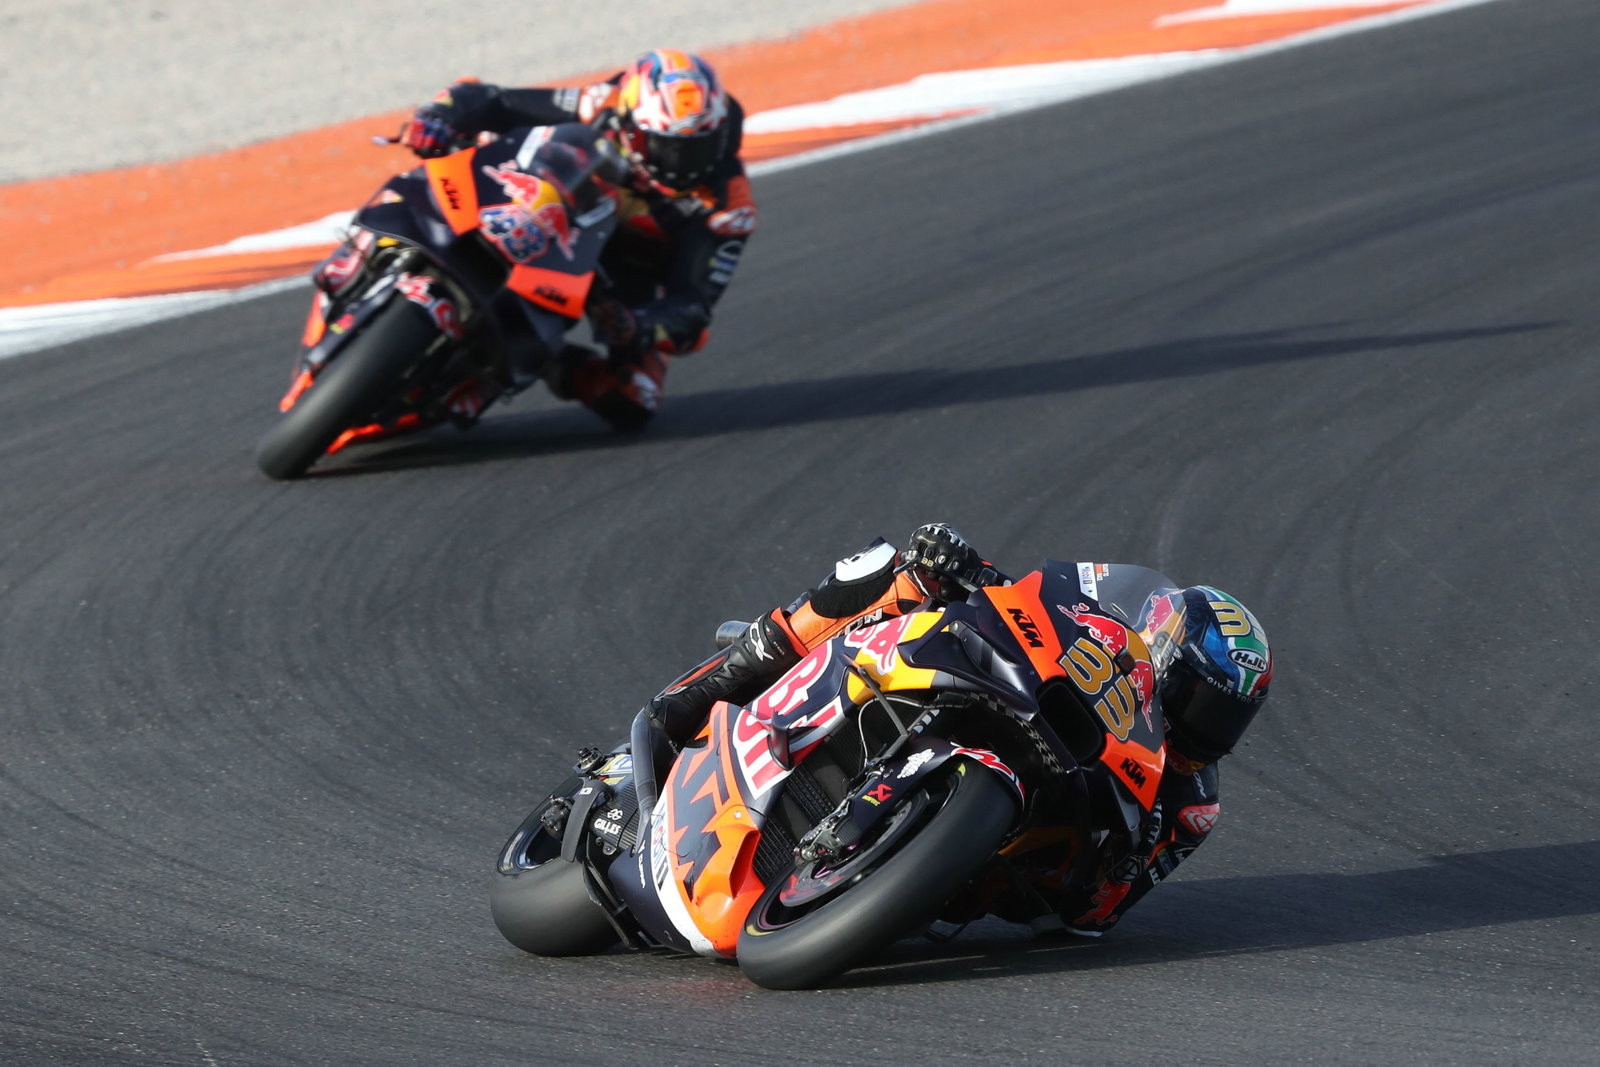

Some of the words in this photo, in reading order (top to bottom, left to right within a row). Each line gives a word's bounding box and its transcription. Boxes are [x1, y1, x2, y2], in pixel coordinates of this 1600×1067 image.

[440, 178, 460, 211] KTM
[534, 285, 569, 306] KTM
[1006, 608, 1045, 648] KTM
[1234, 651, 1267, 671] HJC
[1059, 637, 1135, 741] 33
[1206, 676, 1232, 696] GIVES
[1120, 758, 1147, 789] KTM
[593, 818, 621, 835] GILLES
